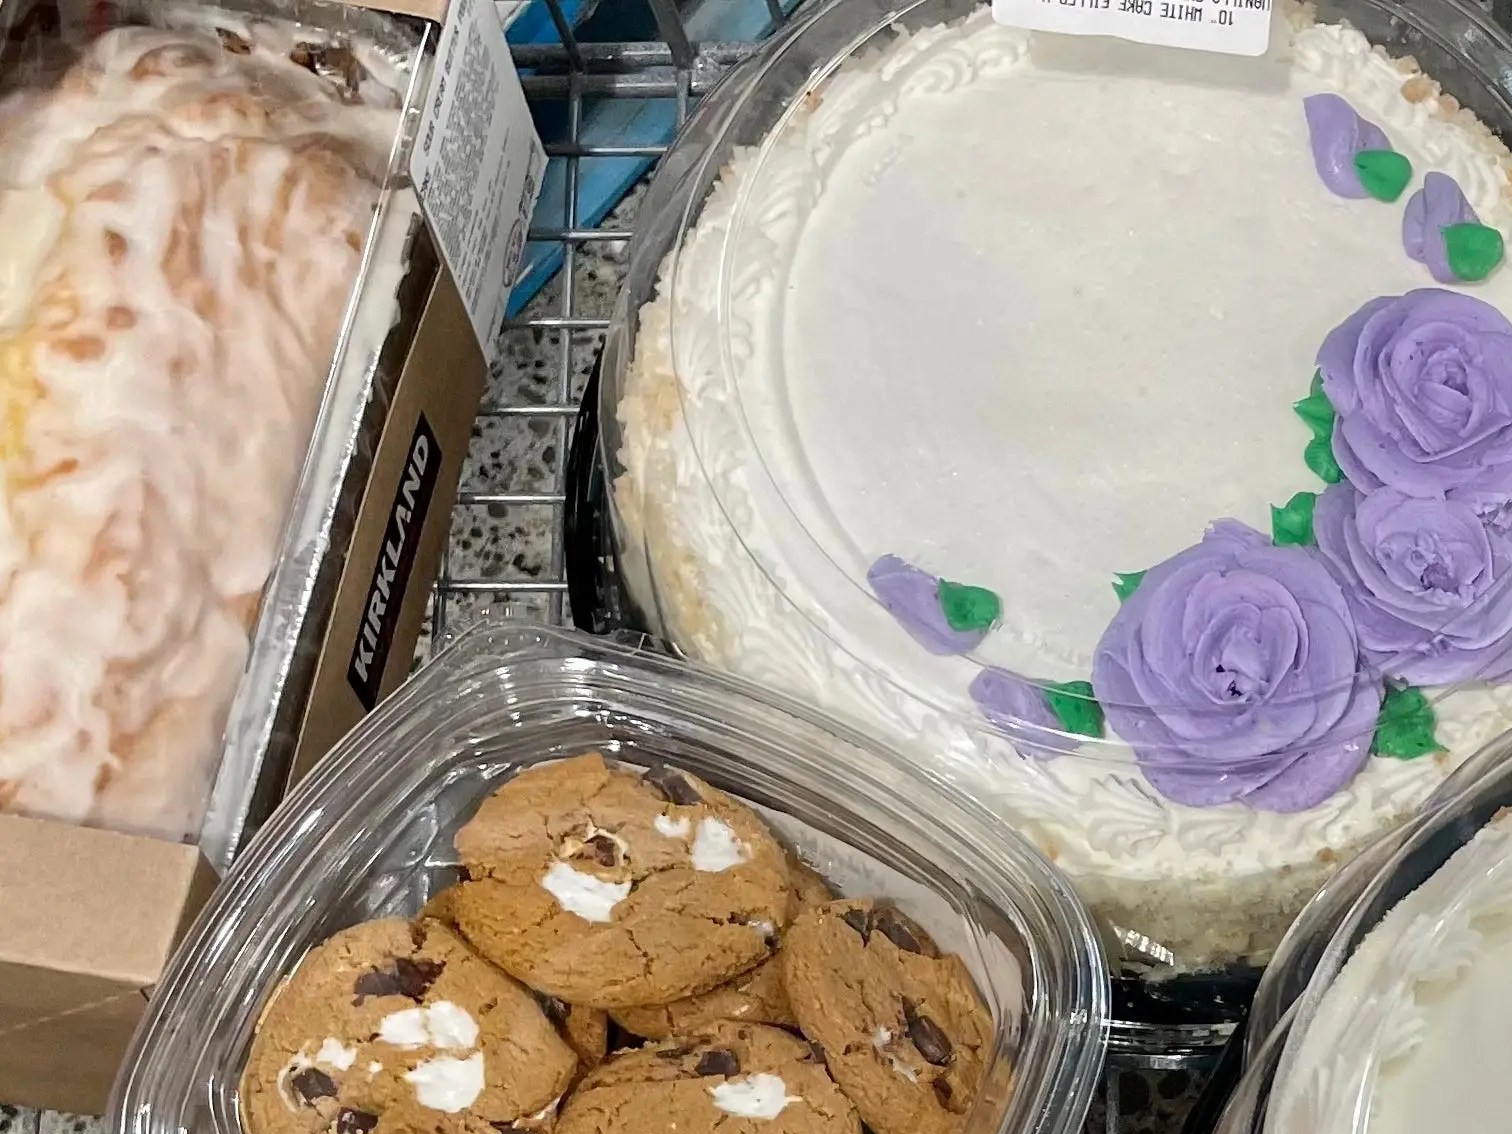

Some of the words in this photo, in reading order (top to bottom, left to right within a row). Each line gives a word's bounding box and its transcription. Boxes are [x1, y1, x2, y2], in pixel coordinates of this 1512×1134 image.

[1118, 0, 1152, 16] CAKE
[1160, 2, 1203, 22] WHITE
[354, 434, 429, 683] KIRKLAND
